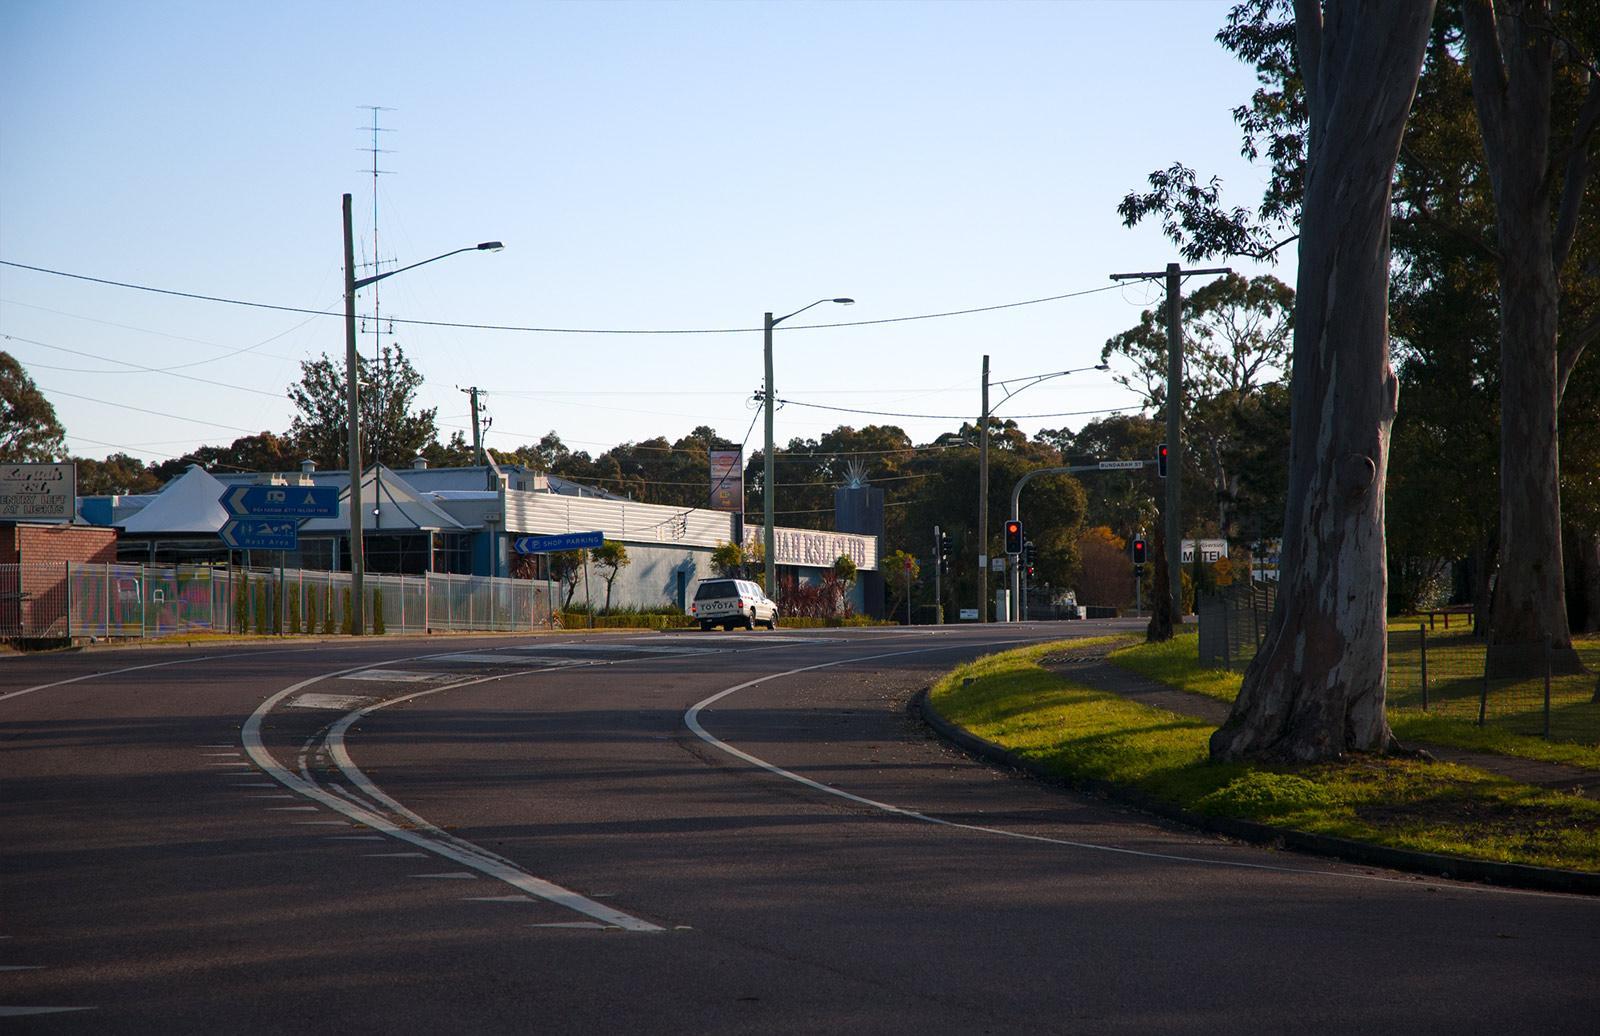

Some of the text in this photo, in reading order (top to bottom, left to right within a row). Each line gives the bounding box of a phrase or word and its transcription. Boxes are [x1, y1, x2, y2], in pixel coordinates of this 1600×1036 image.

[1, 496, 65, 504] ENTRY LEFT
[3, 505, 64, 514] AT LIGHTS
[544, 540, 562, 548] SHOP
[566, 537, 599, 545] PARKING
[804, 533, 831, 565] RSL
[702, 603, 735, 611] TOYOTA
